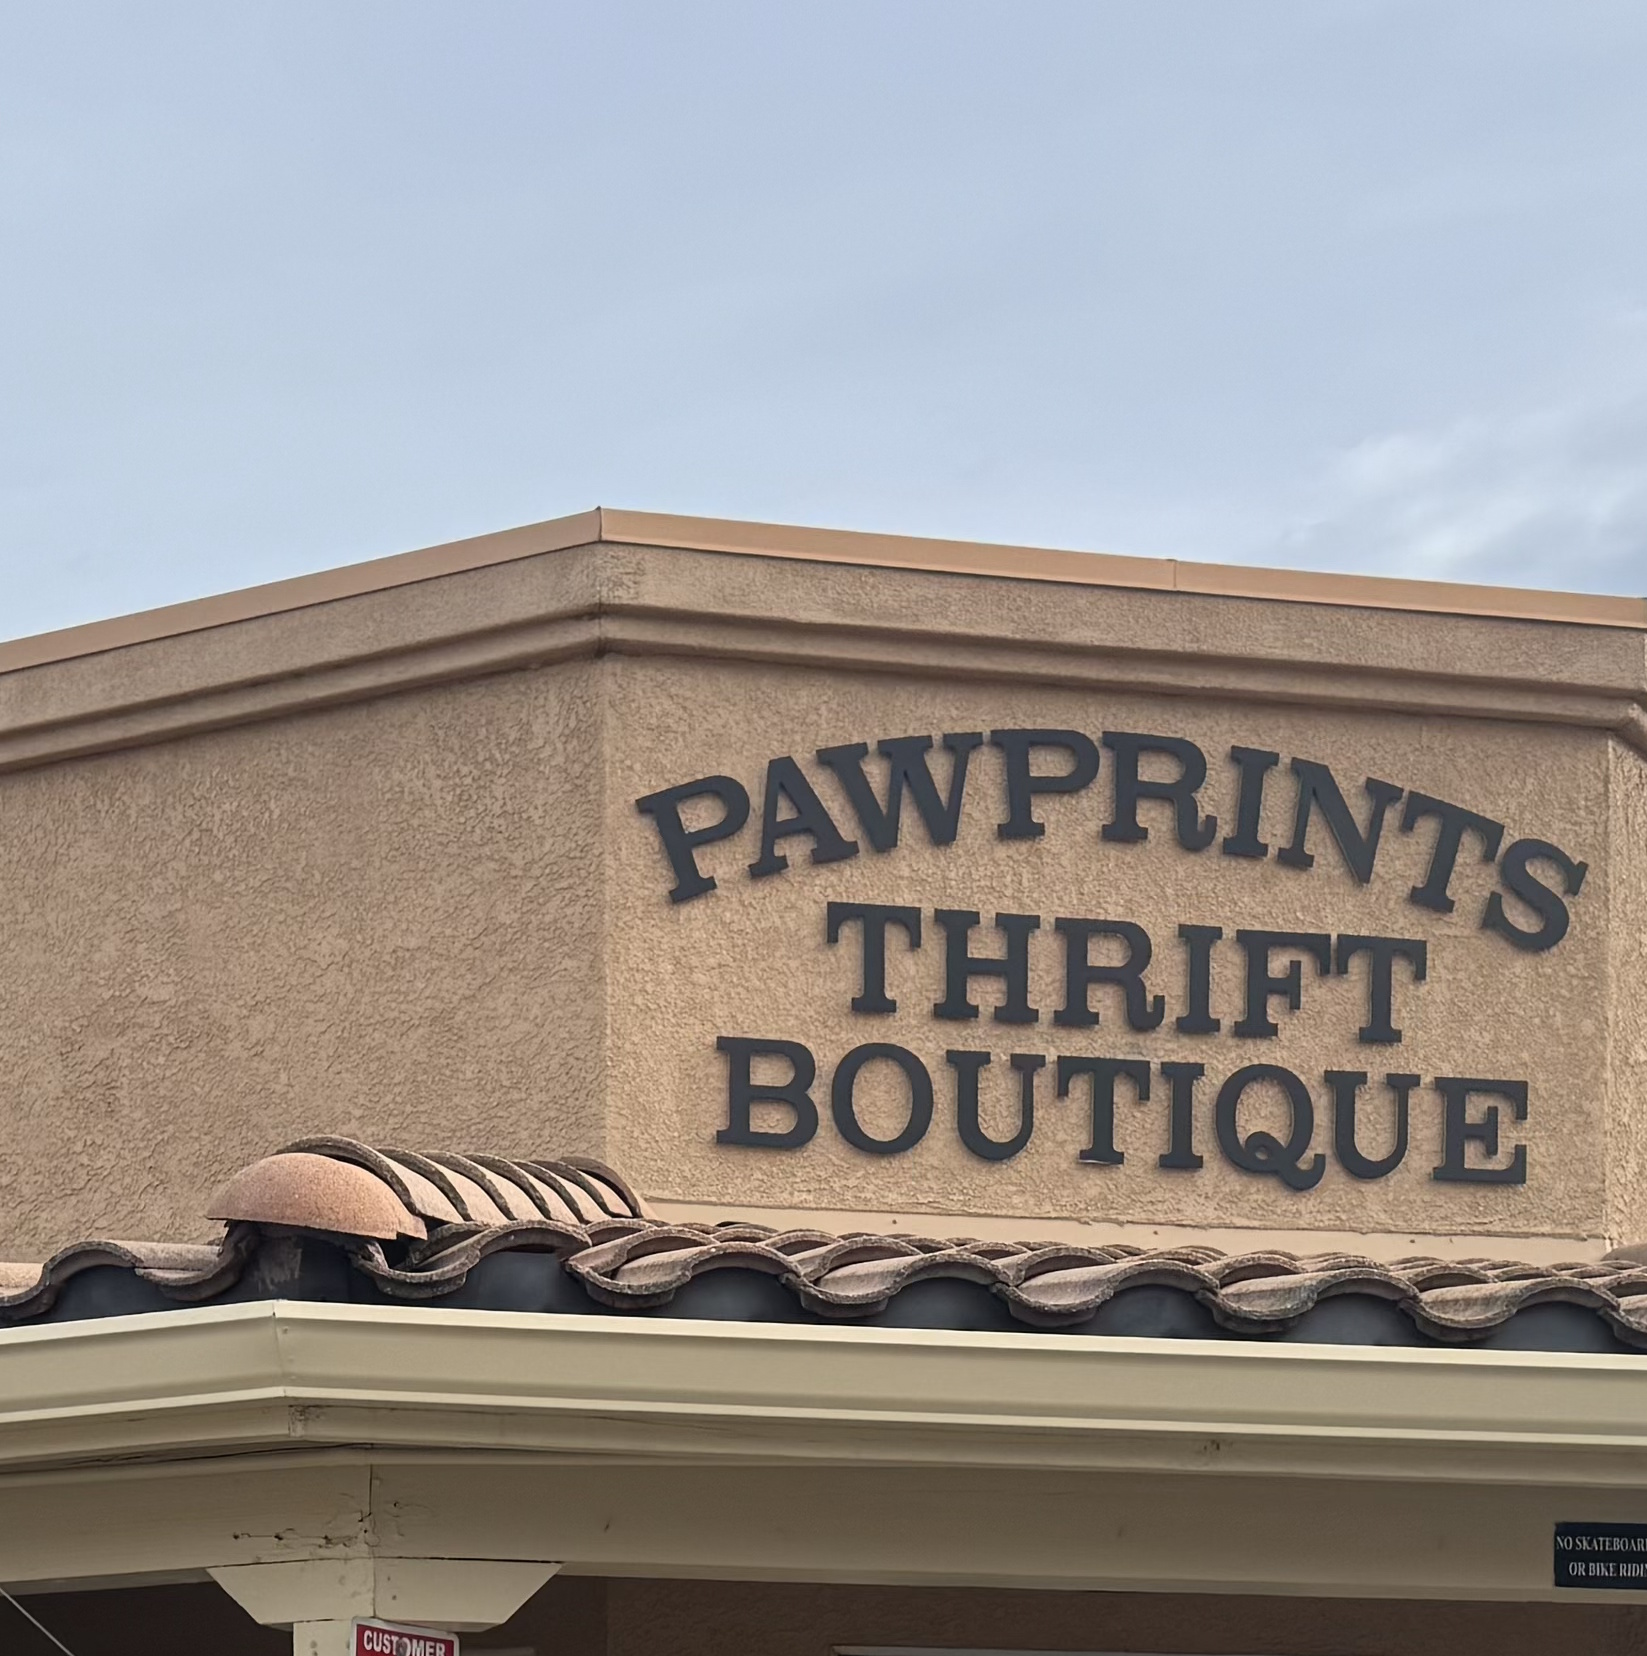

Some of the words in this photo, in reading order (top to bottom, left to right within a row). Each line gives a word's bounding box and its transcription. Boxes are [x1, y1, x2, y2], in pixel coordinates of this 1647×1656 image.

[635, 728, 1588, 952] PAWPRINTS
[826, 901, 1427, 1044] THRIFT
[715, 1035, 1529, 1191] BOUTIQUE
[1556, 1536, 1573, 1551] NO
[1568, 1562, 1586, 1576] OR
[1589, 1562, 1616, 1577] BIKE
